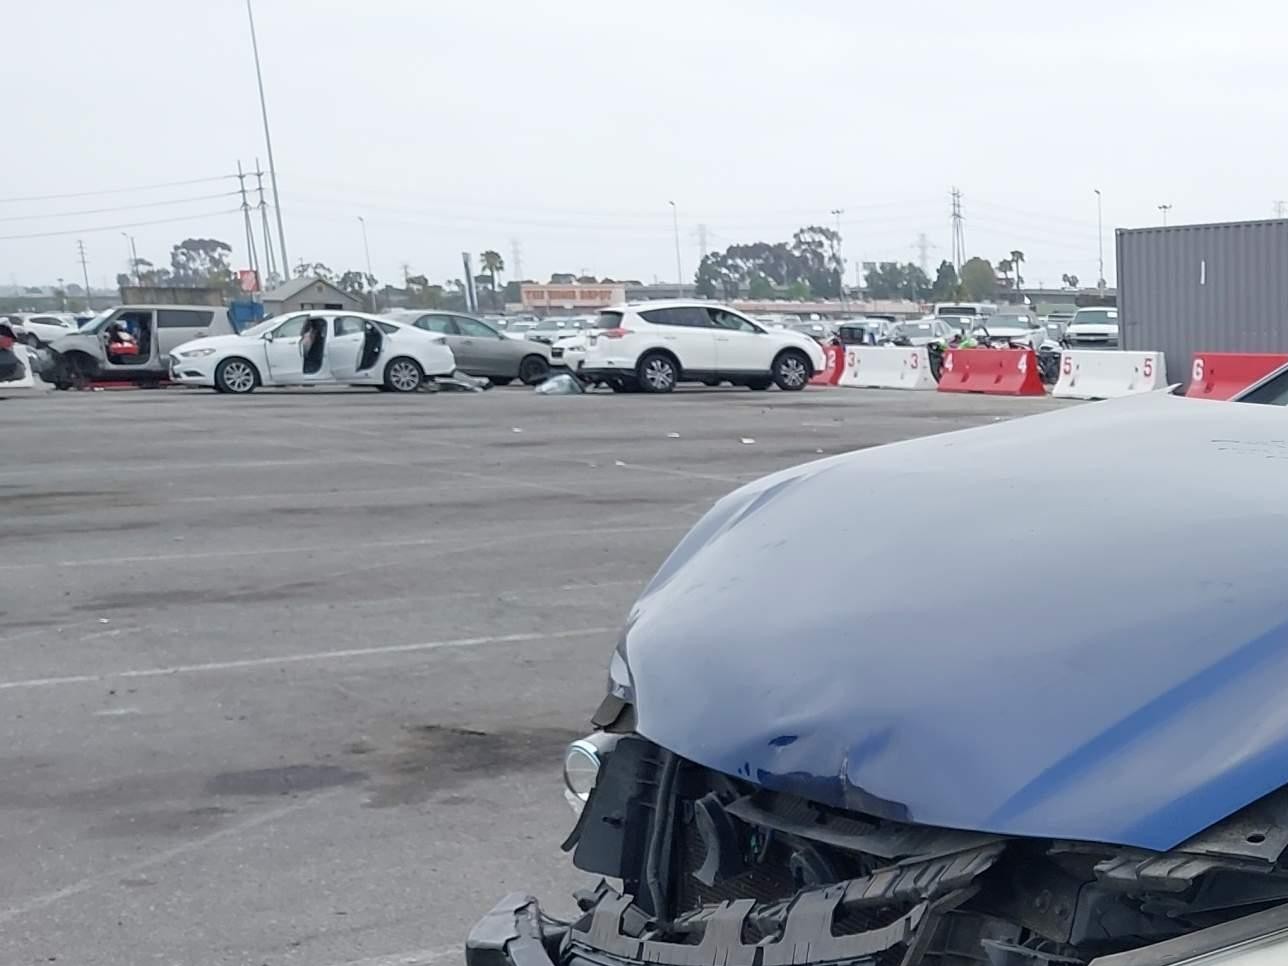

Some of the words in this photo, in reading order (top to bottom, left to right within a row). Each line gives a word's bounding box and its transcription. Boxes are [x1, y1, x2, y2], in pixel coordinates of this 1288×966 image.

[827, 350, 837, 369] 2
[847, 351, 856, 368] 3
[910, 352, 919, 369] 3
[944, 353, 953, 372] 4
[1018, 353, 1028, 374] 4
[1063, 356, 1073, 375] 5
[1143, 357, 1153, 377] 5
[1192, 358, 1204, 381] 6
